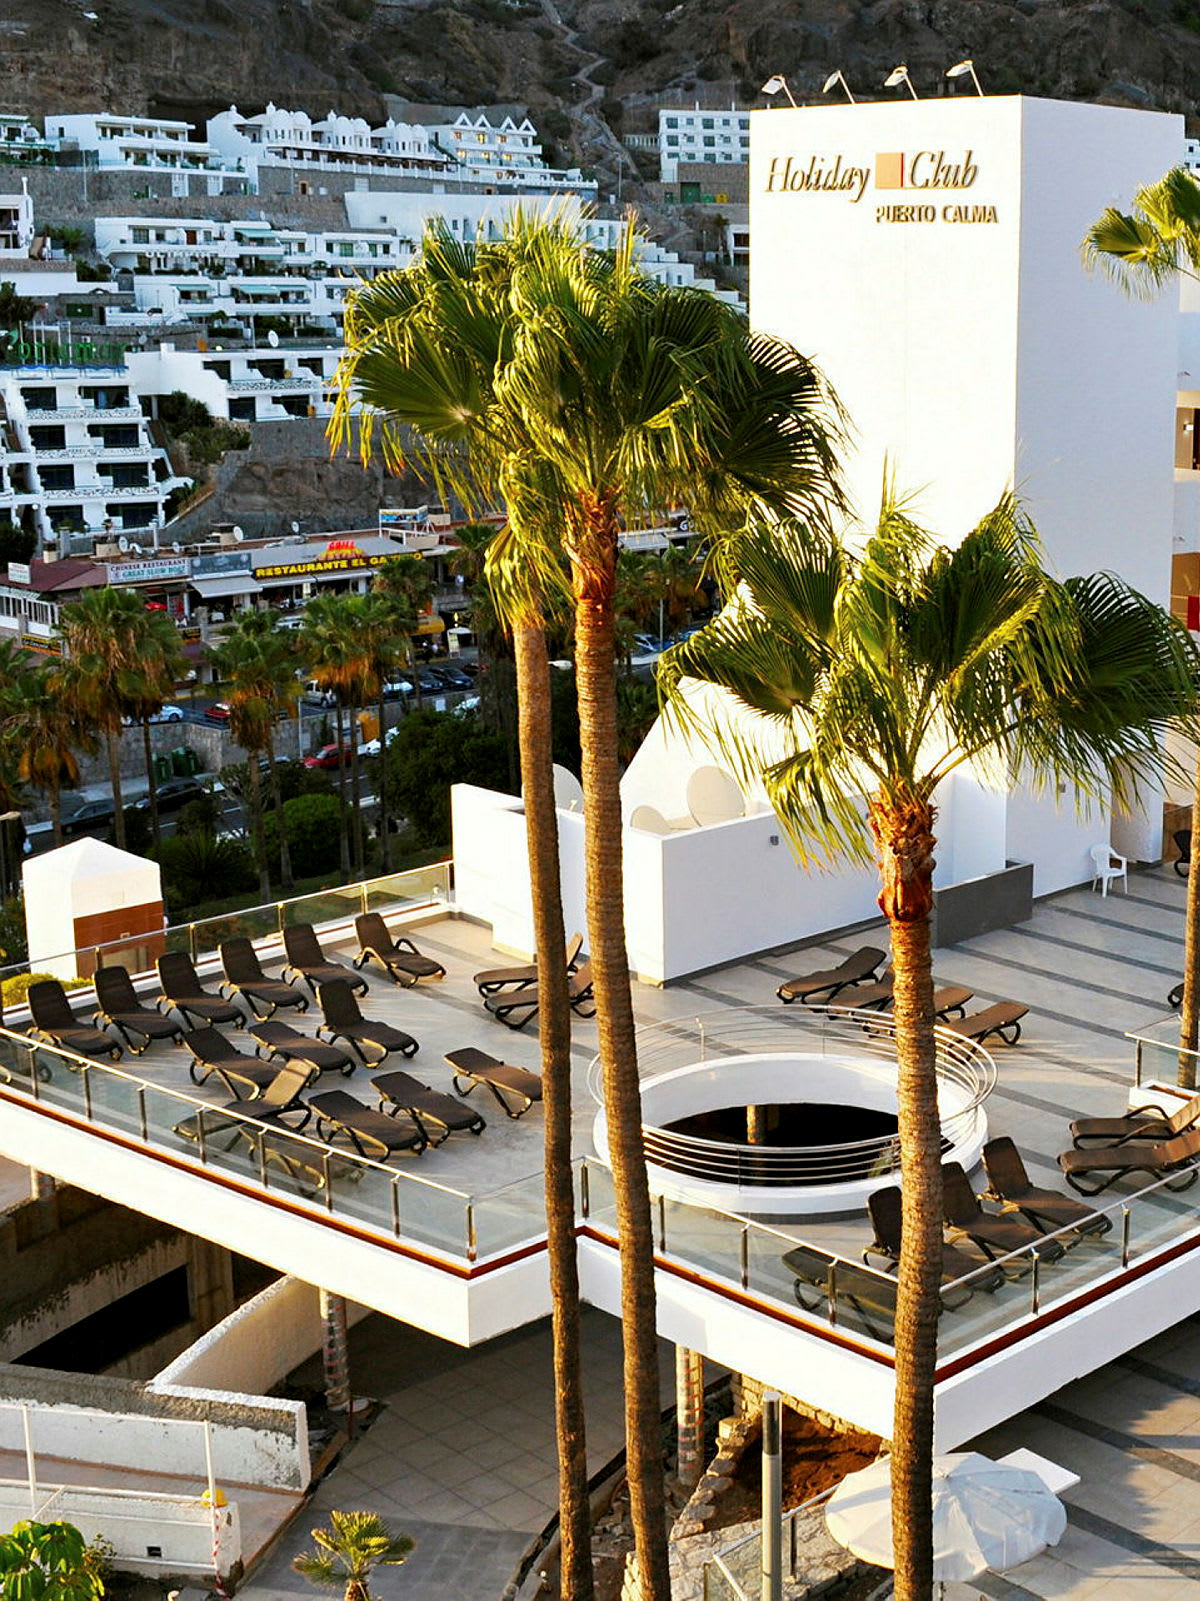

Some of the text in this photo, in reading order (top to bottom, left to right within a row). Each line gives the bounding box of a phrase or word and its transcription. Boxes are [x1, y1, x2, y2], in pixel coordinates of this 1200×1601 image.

[765, 149, 980, 203] Holiday Club
[876, 204, 999, 224] PUERTO CALMA
[110, 563, 140, 572] CHINESE
[143, 559, 186, 568] RESTAURANT
[255, 559, 348, 577] RESTAURANTE
[351, 558, 367, 567] EL
